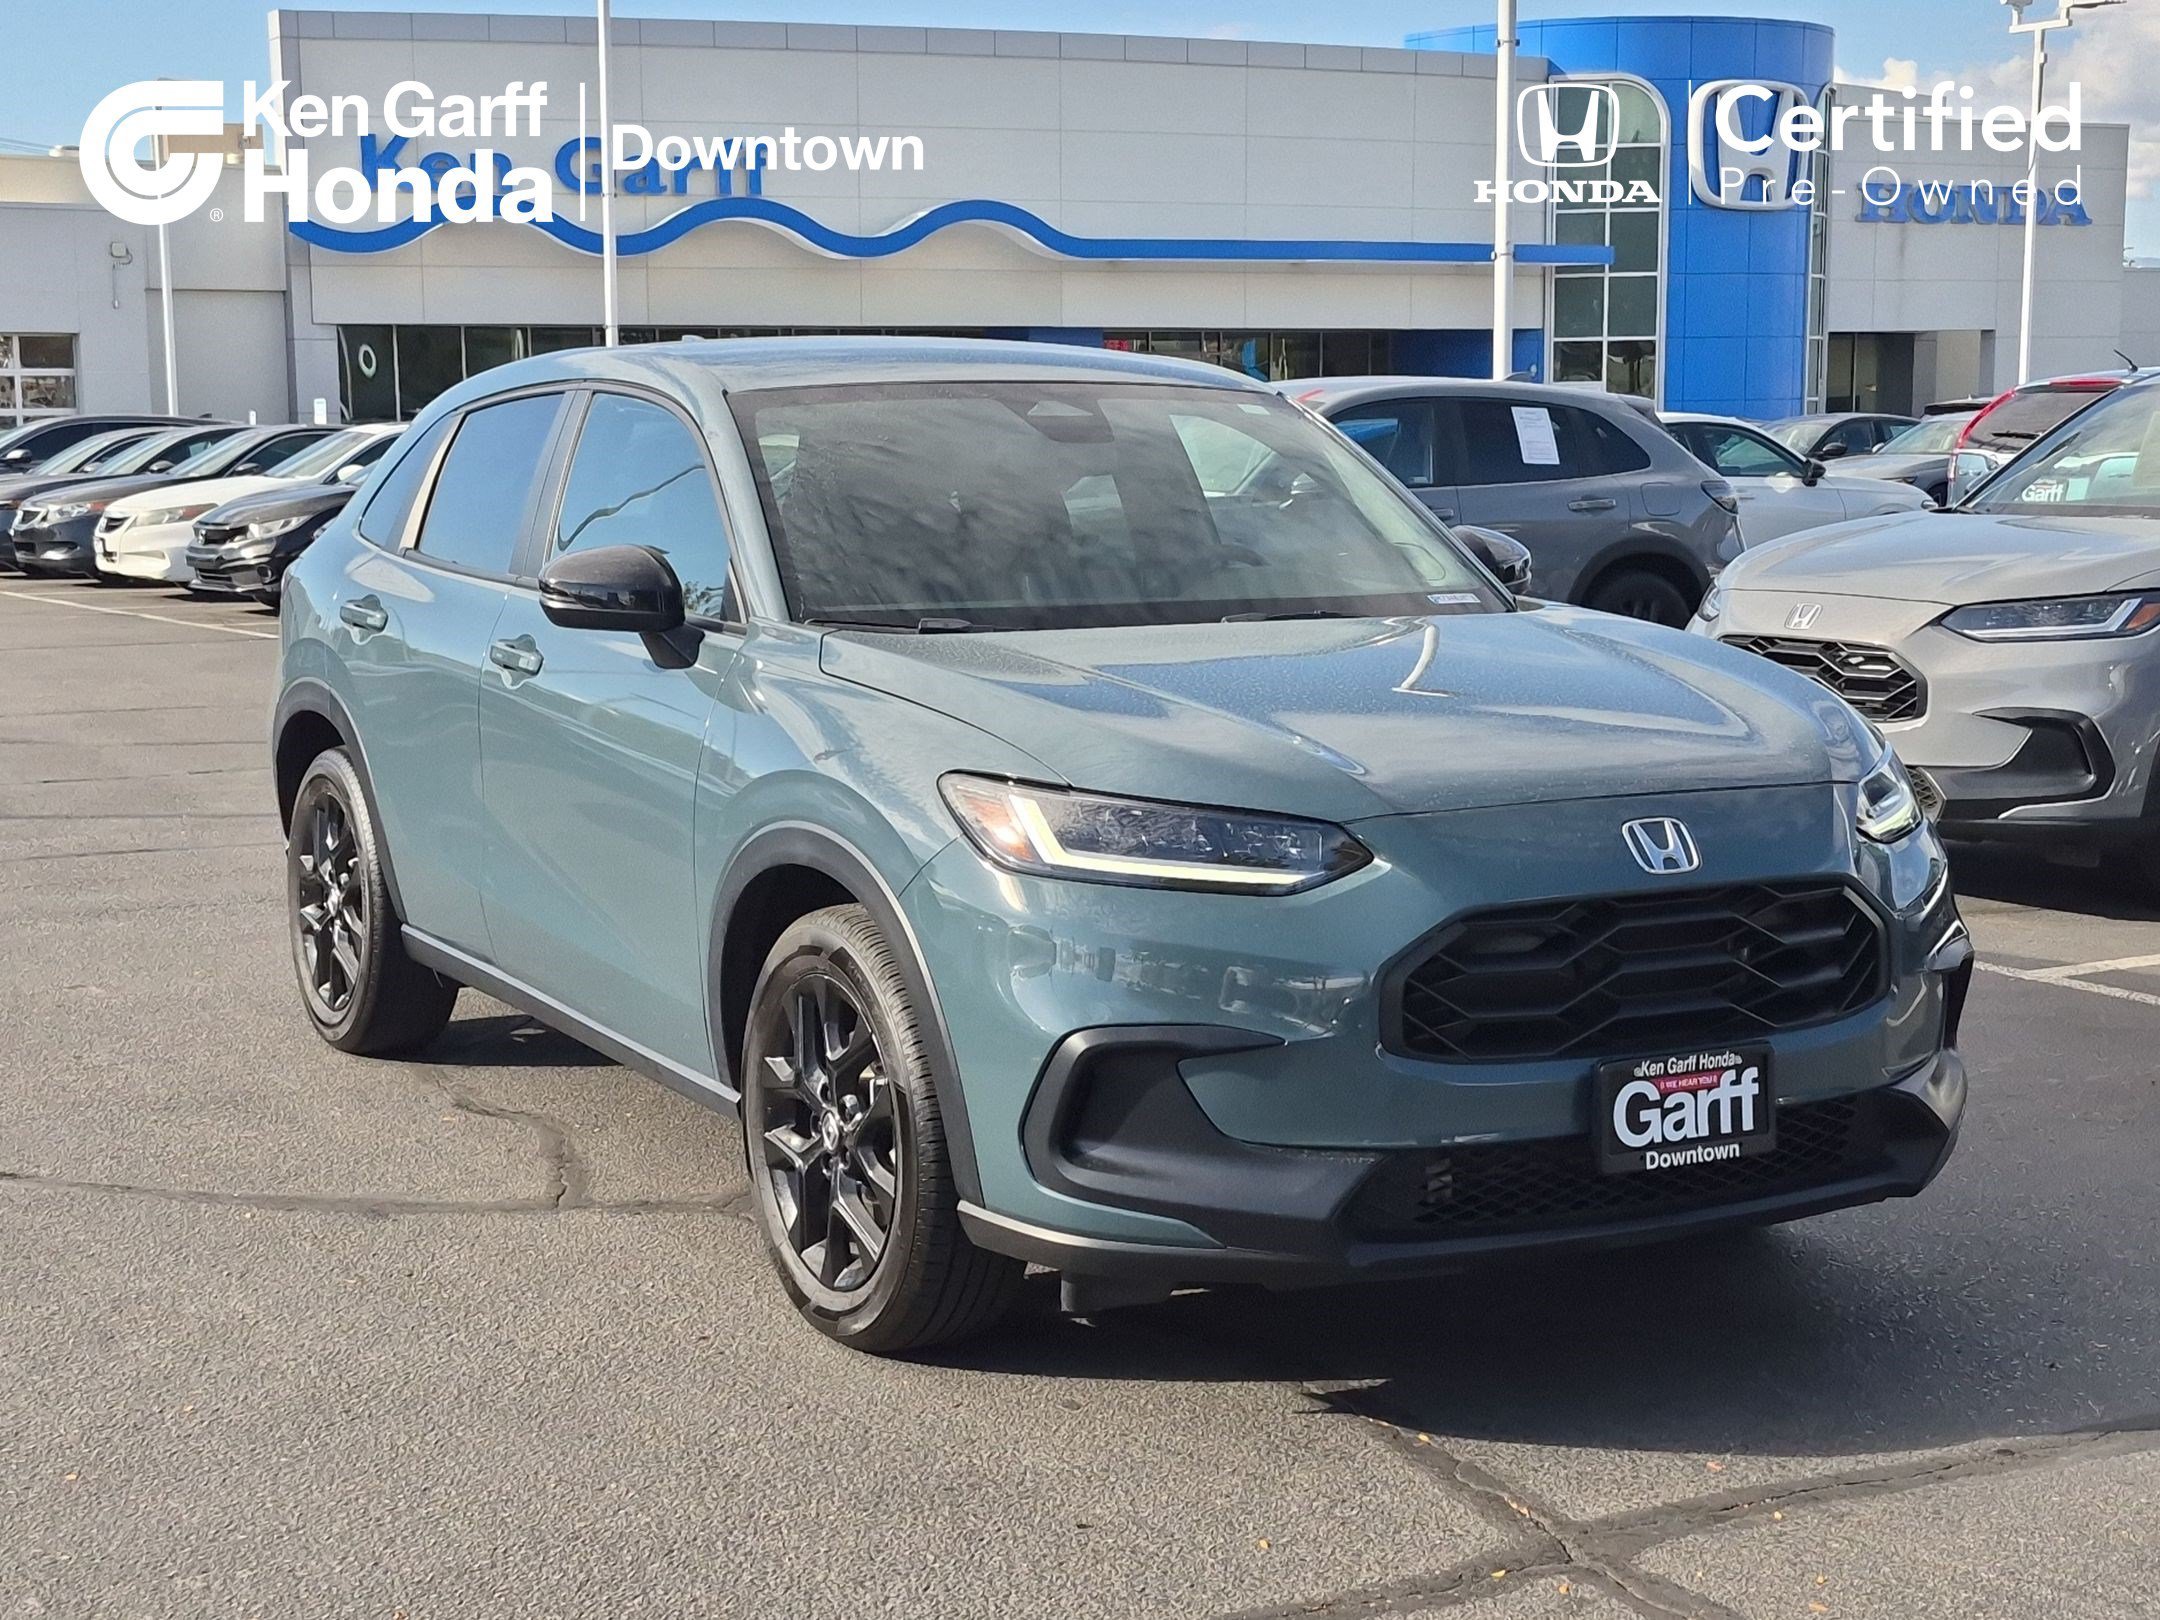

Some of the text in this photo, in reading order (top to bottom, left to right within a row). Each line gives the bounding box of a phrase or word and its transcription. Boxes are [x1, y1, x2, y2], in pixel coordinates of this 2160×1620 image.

[1855, 183, 2093, 226] HONDA
[2021, 483, 2064, 502] Garff
[1641, 1051, 1735, 1077] Ken Garff Honda
[1613, 1067, 1759, 1148] Garff
[1645, 1143, 1740, 1170] Downtown
